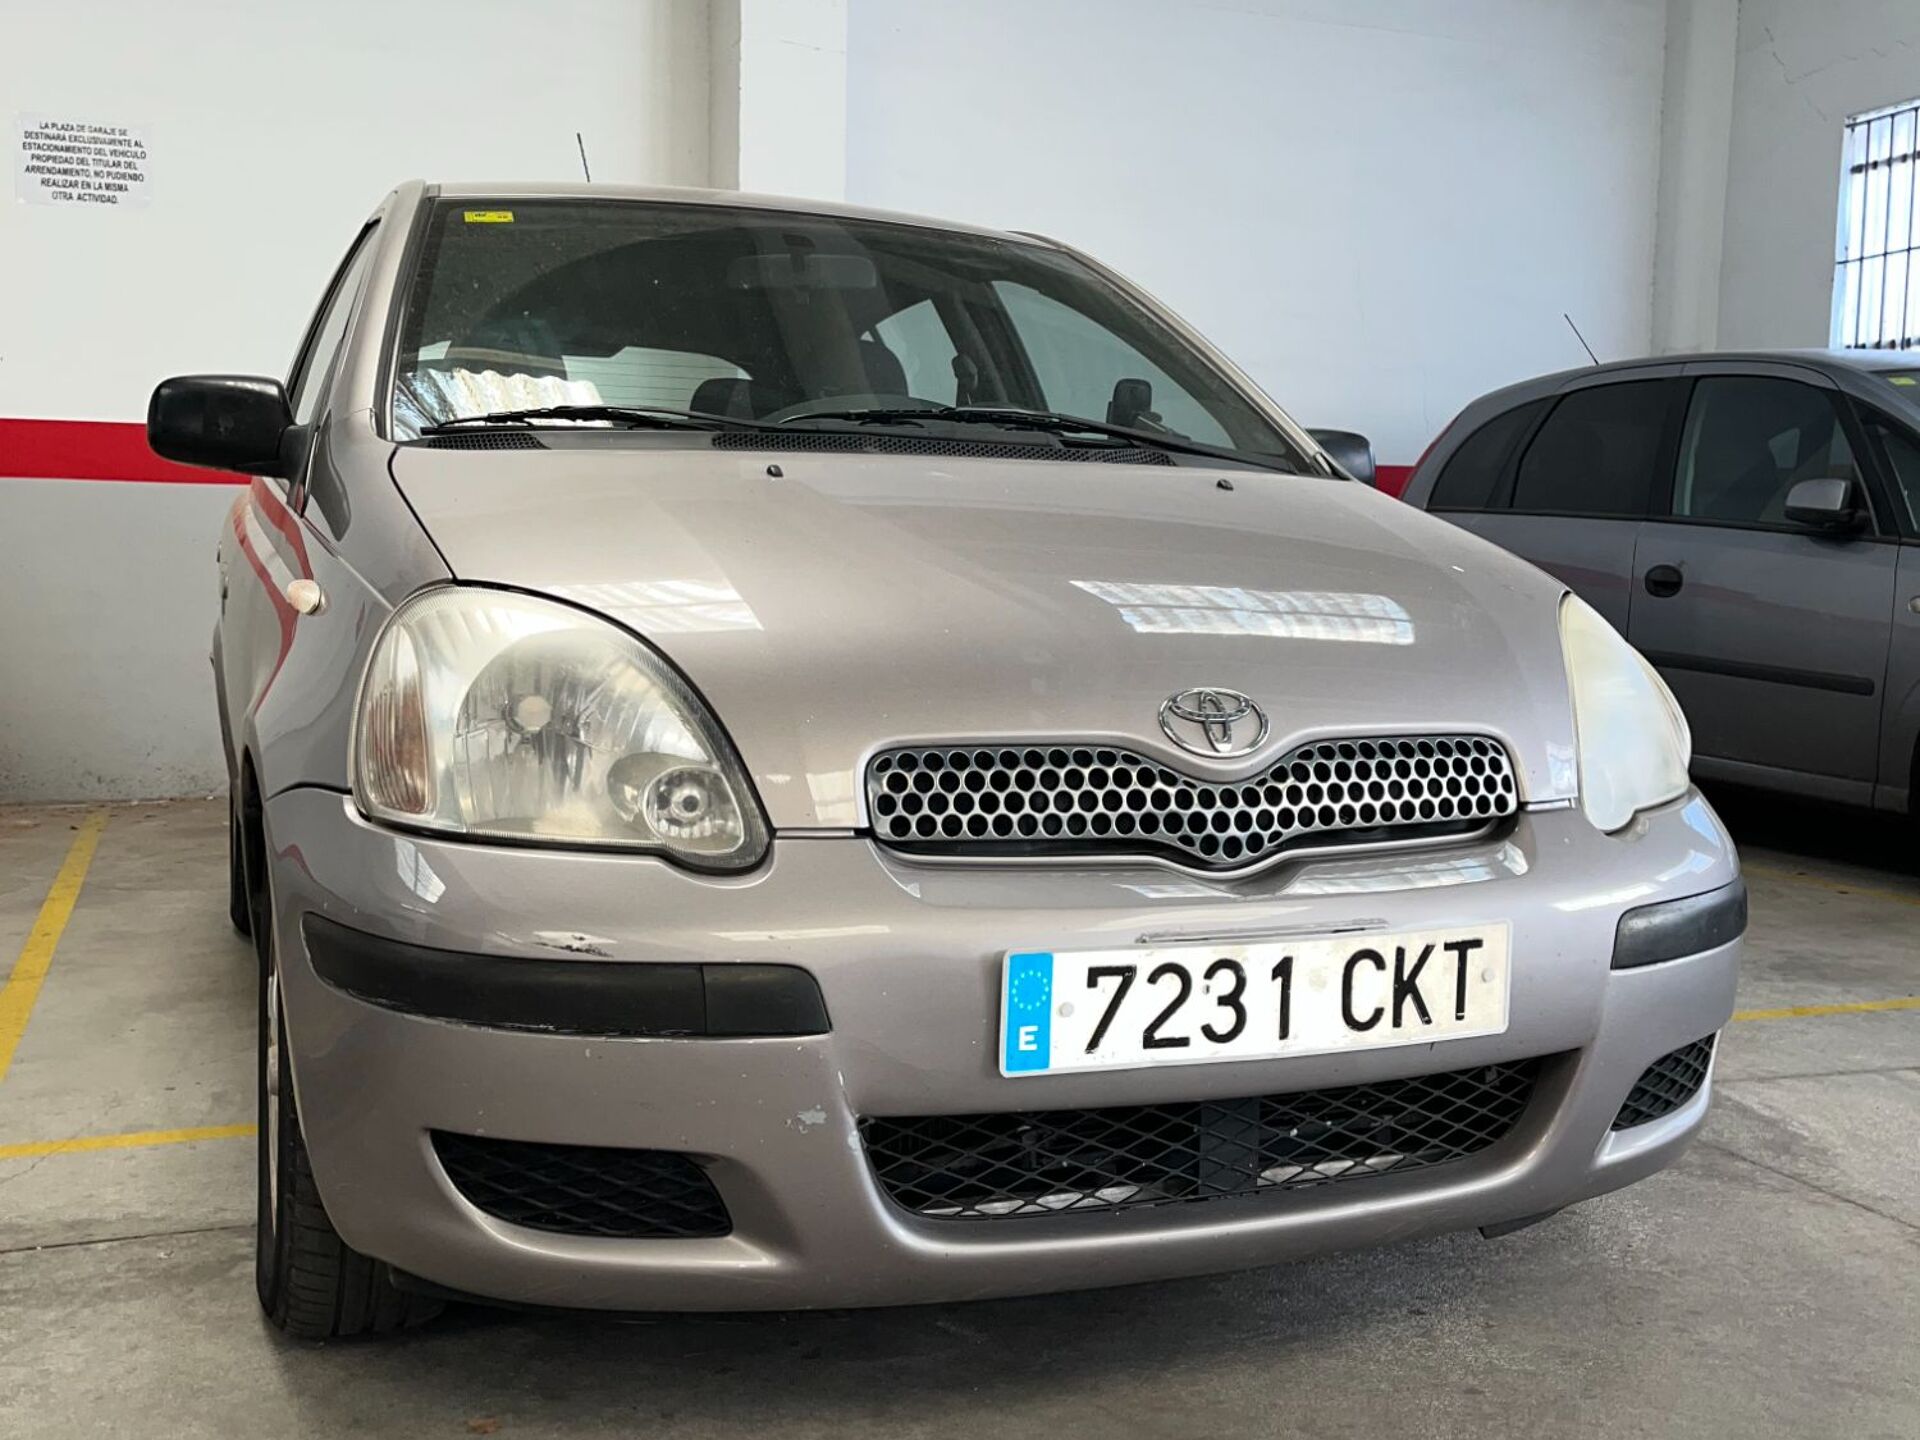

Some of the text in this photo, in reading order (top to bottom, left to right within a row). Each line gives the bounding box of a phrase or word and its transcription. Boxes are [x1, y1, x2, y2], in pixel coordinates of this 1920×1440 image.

[40, 121, 49, 130] LA
[51, 122, 74, 131] PLAZA
[22, 142, 92, 155] ESTACIONAMIENTO
[94, 148, 107, 156] DEL
[134, 140, 144, 148] AL
[31, 153, 137, 170] PROPIEDAD DEL TITULAR DEL
[94, 170, 105, 178] NO
[106, 171, 144, 182] PUDIENDO
[41, 177, 129, 191] REALIZAR EN LA MISMA
[52, 191, 73, 200] OTRA
[1085, 939, 1484, 1054] 7231 CKT
[1018, 1025, 1038, 1051] E
